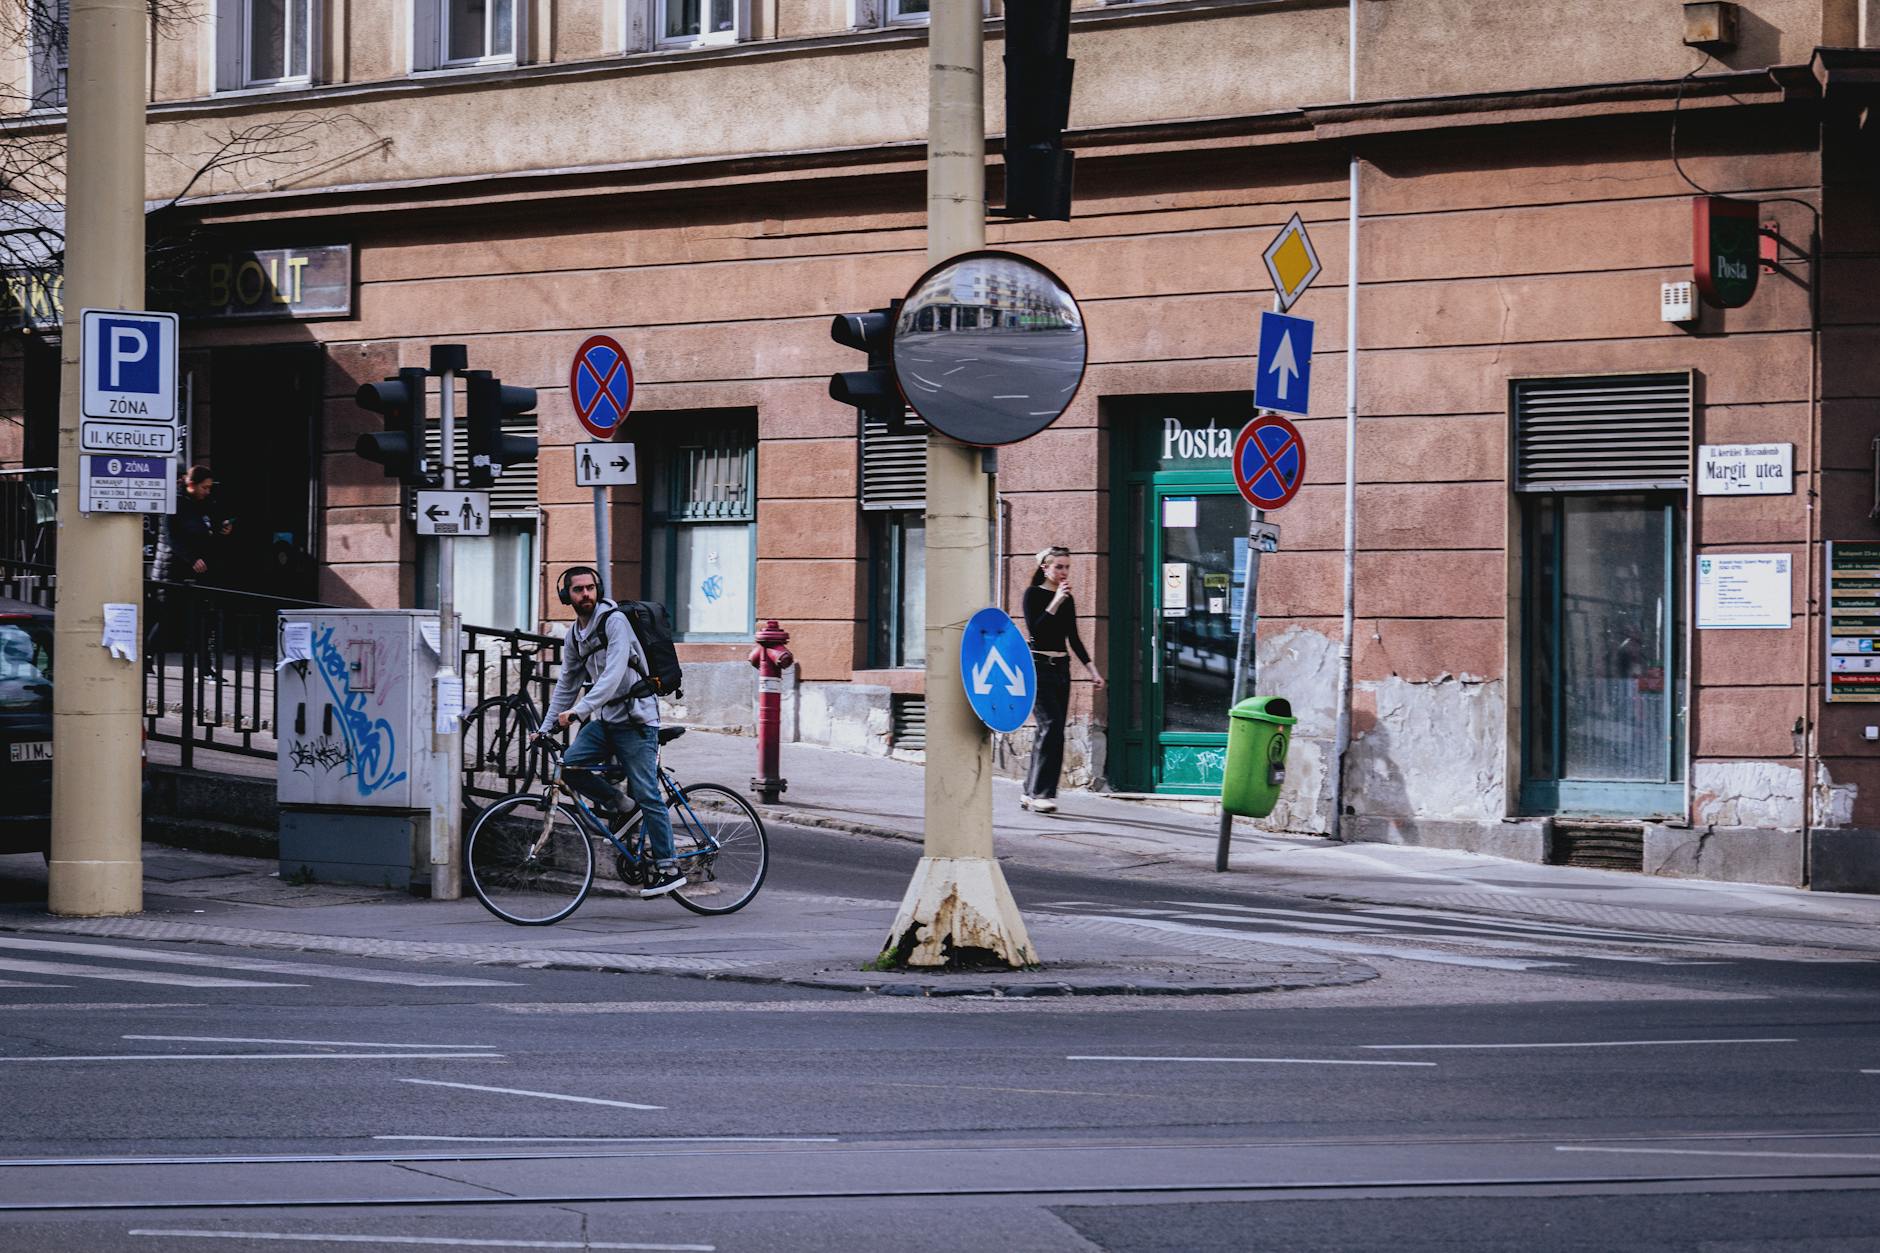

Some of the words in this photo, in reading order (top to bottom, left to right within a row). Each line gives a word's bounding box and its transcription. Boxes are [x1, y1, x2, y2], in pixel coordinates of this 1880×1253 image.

[1717, 255, 1747, 279] Posta
[210, 257, 308, 306] BOLT
[110, 326, 149, 387] P
[109, 395, 148, 414] ZÓNA
[90, 431, 102, 443] II.
[106, 430, 166, 447] KERÜLET
[1162, 417, 1234, 459] Posta
[125, 461, 150, 473] ZÓNA
[1706, 461, 1746, 484] Margit
[1756, 462, 1783, 478] utca
[118, 501, 137, 510] 0202
